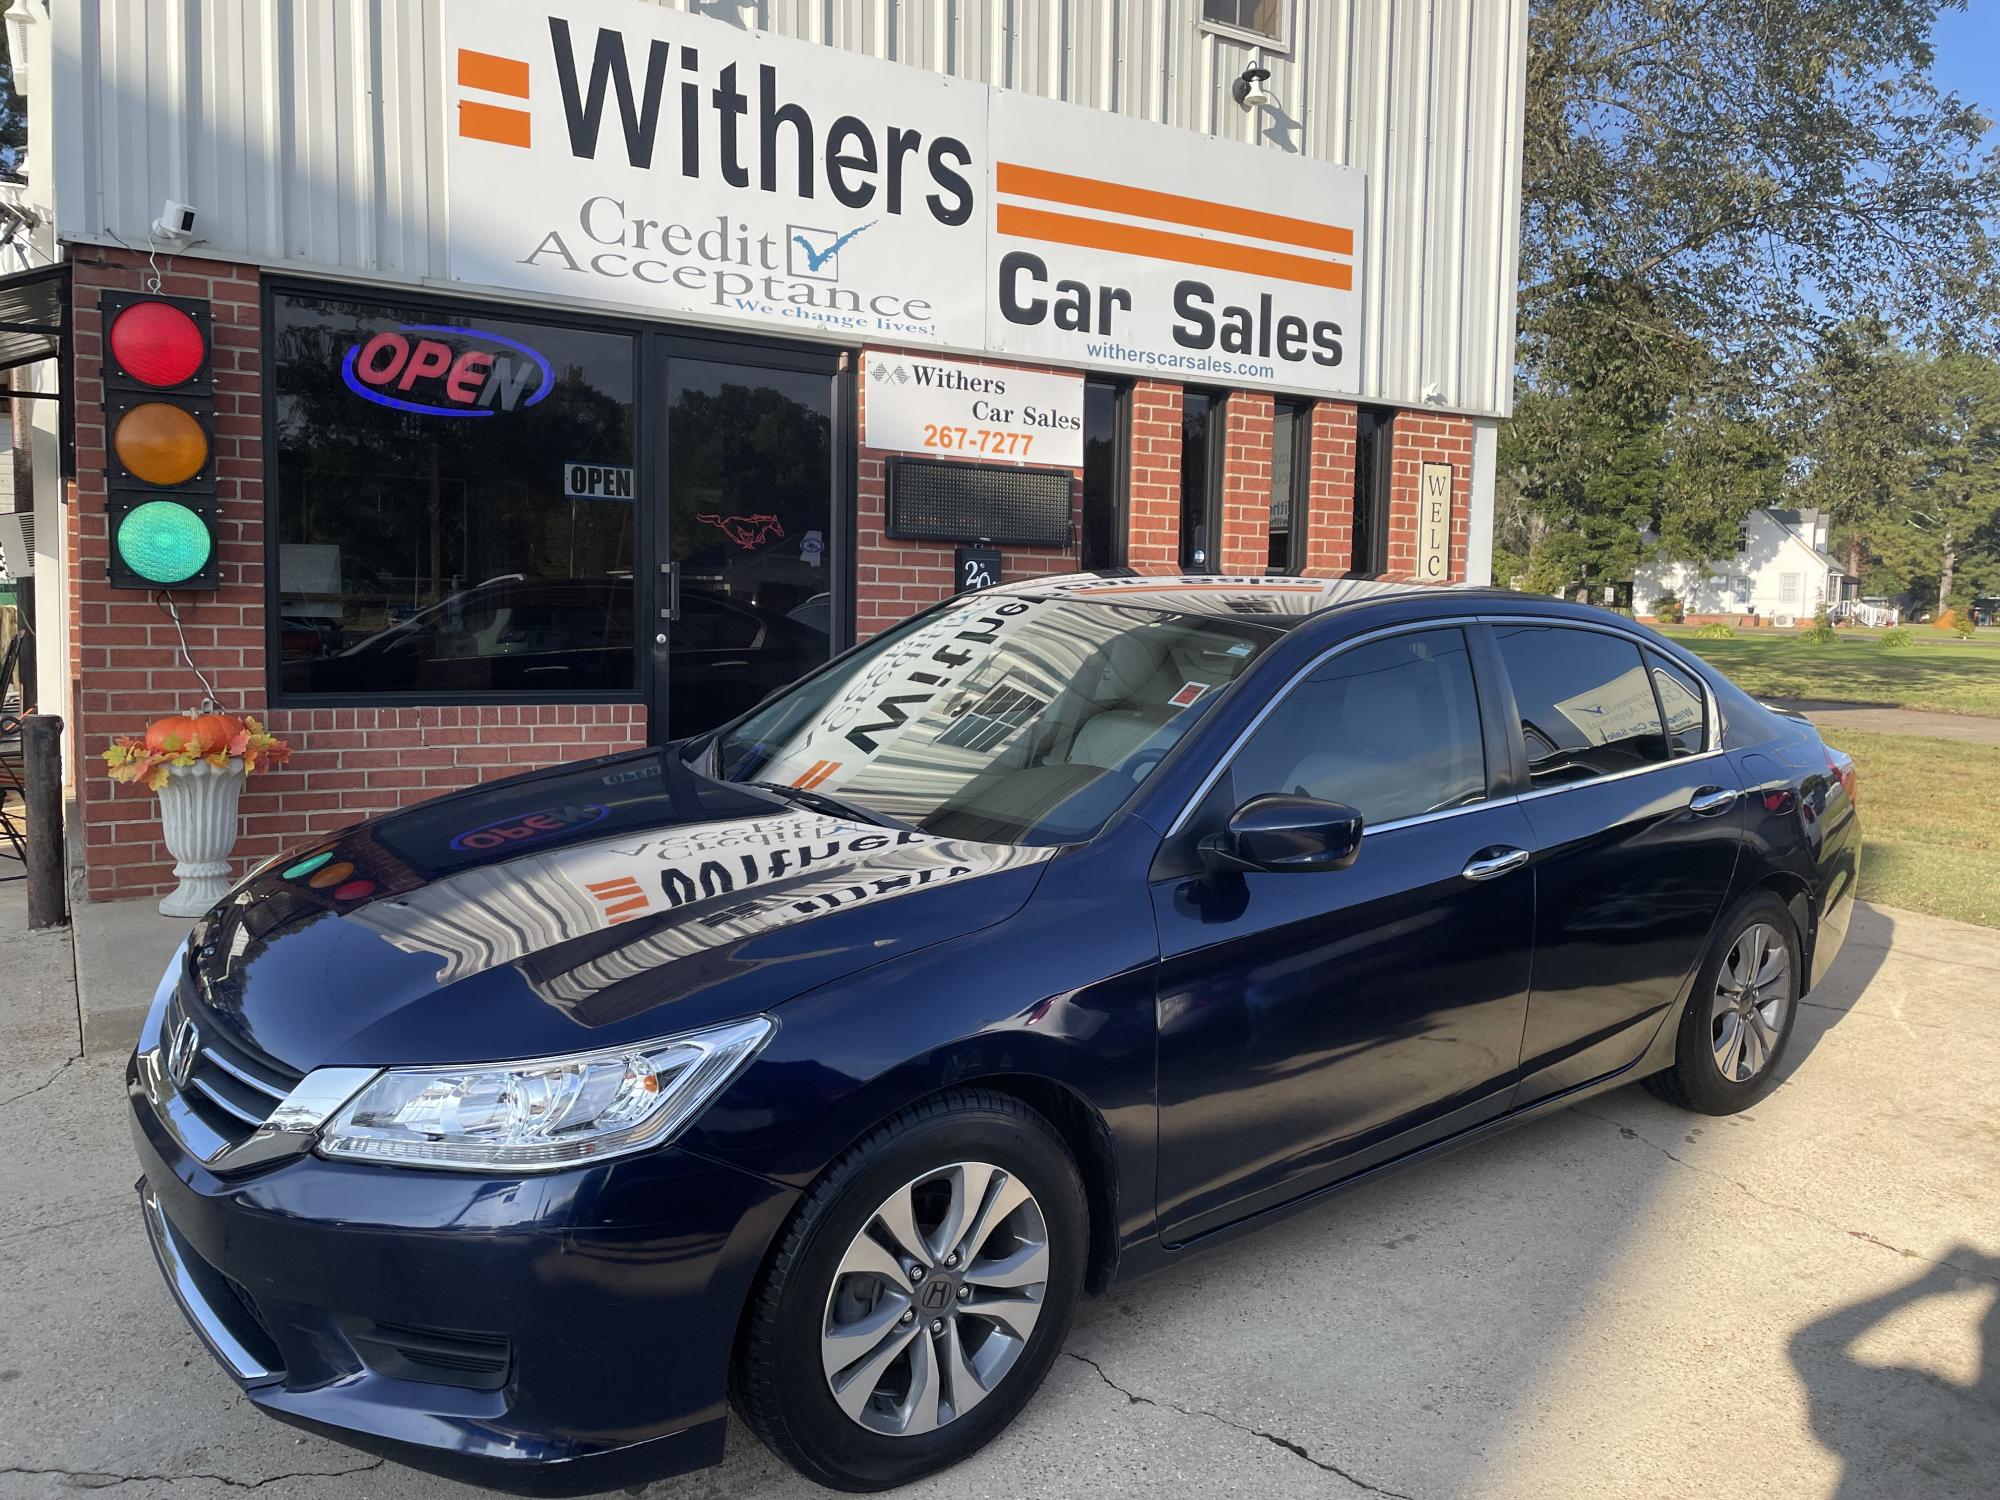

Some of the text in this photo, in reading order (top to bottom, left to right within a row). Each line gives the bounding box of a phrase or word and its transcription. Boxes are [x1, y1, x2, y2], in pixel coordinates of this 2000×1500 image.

[548, 16, 974, 227] Withers
[580, 196, 778, 271] Credit
[516, 231, 933, 322] Acceptance
[735, 298, 936, 336] We change lives!
[999, 251, 1343, 368] Car Sales
[357, 332, 533, 411] OPEN
[912, 364, 1006, 395] Withers
[1087, 342, 1274, 379] witherscarsales.com
[972, 401, 1081, 431] Car Sales
[923, 424, 1034, 456] 267-7277
[571, 466, 631, 496] OPEN
